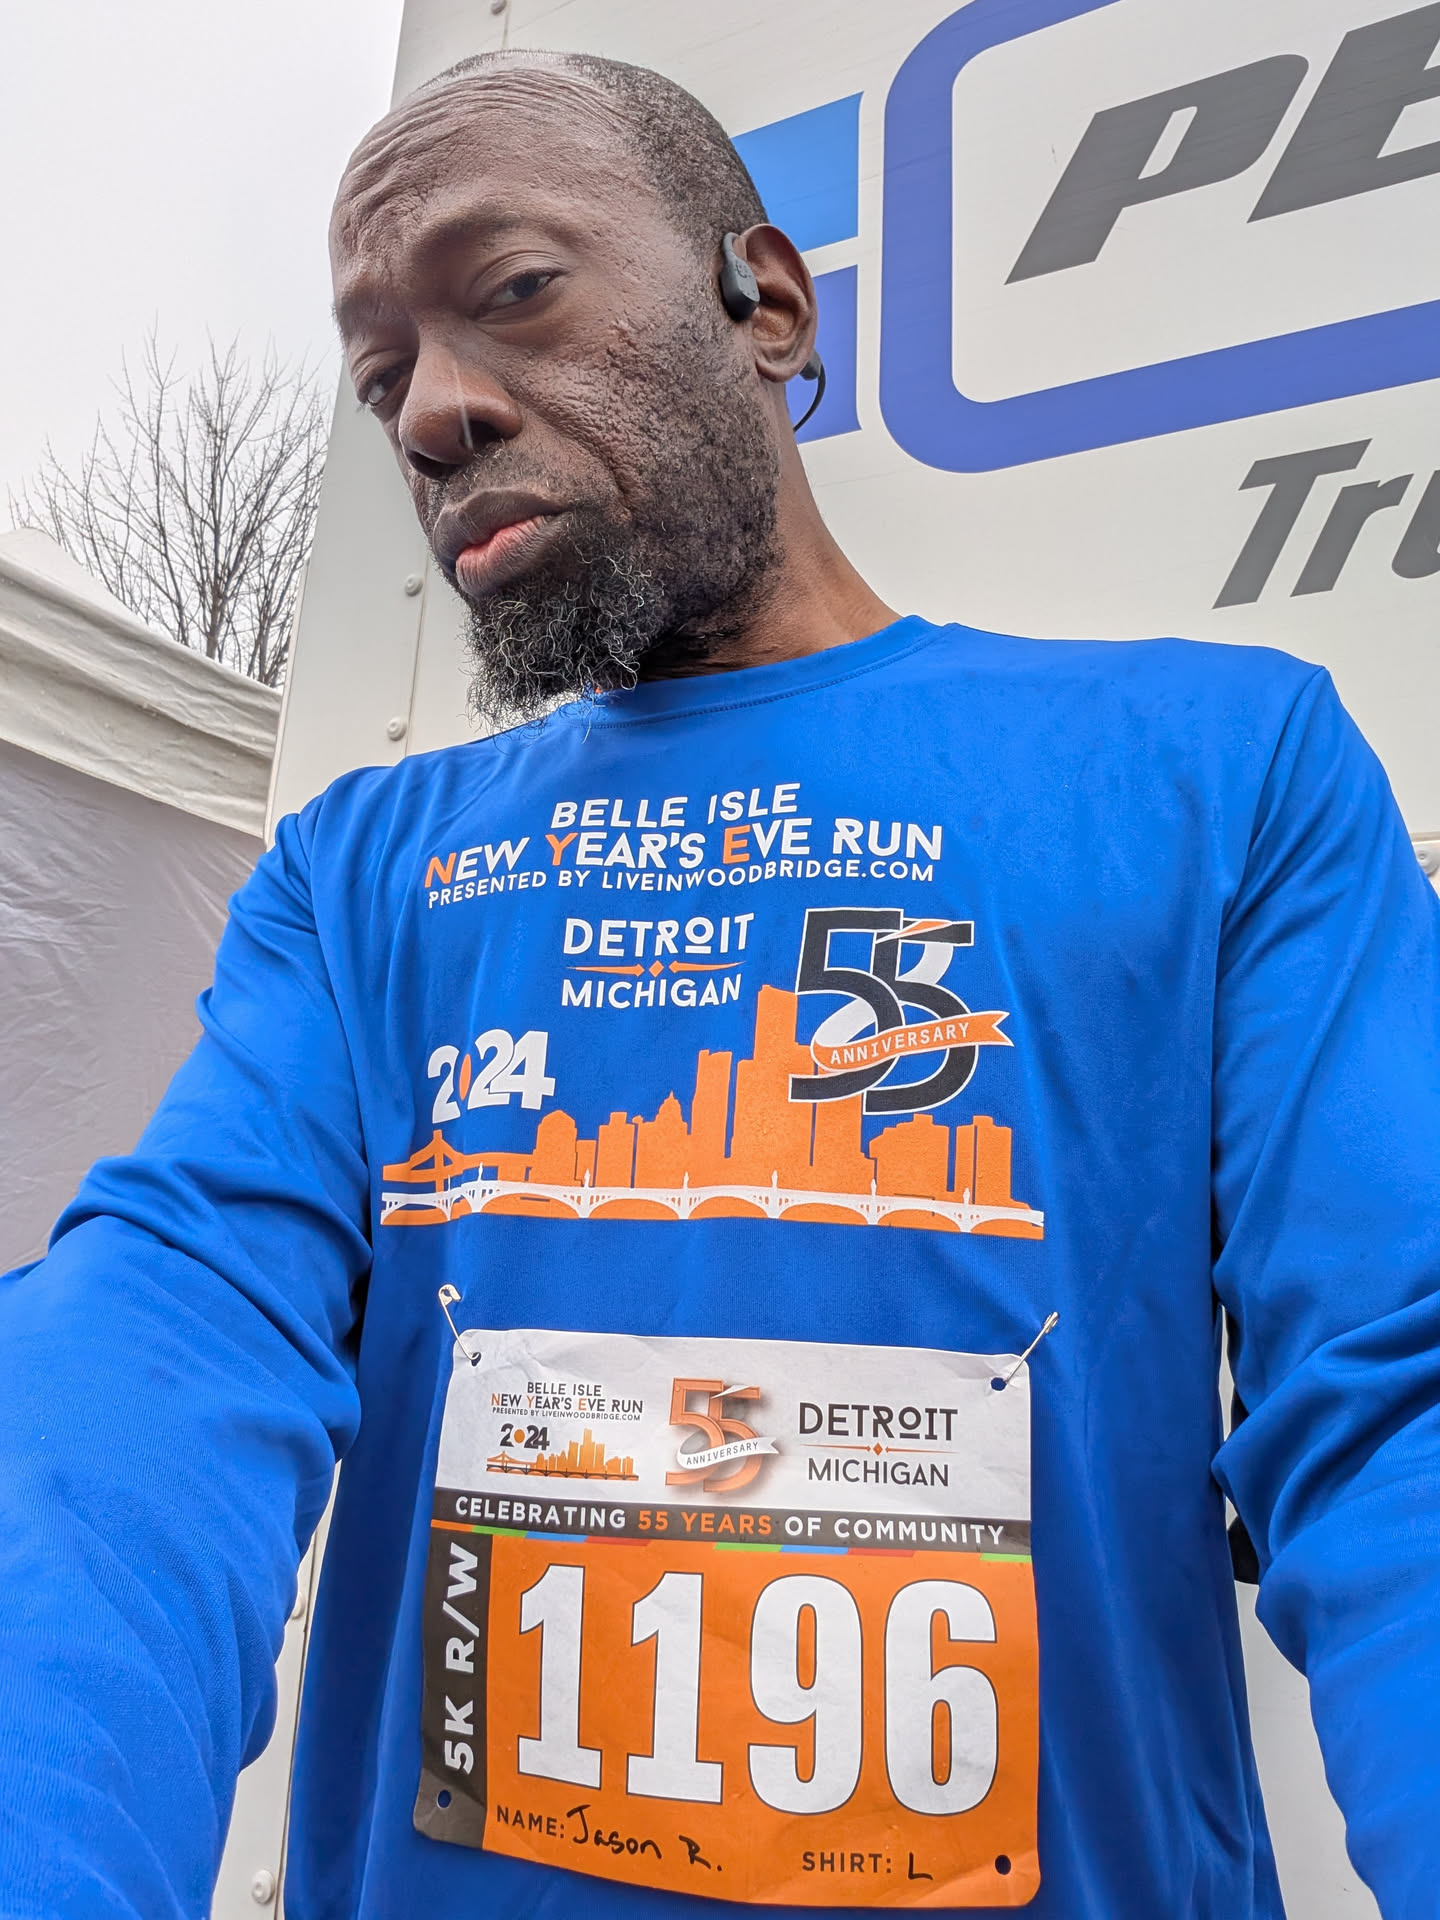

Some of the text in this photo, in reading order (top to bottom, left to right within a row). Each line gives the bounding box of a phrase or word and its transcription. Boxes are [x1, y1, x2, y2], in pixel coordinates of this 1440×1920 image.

[551, 782, 800, 829] BELLE ISLE
[424, 817, 943, 887] NEW YEAR'S EVE RUN
[428, 859, 934, 909] PRESENTED BY LIVEINWOODBRIDGE.COM
[562, 913, 755, 957] DETROIT
[561, 973, 742, 1010] MICHIGAN
[829, 1022, 970, 1065] ANNIVERSARY
[491, 1393, 643, 1414] NEW YEAR'S EVE RUN
[527, 1382, 602, 1397] BELLE ISLE
[492, 1407, 528, 1416] PRESENTED
[542, 1411, 641, 1421] LIVEINWOODBRIDGE.COM
[799, 1402, 959, 1442] DETROIT
[665, 1378, 762, 1493] 55
[686, 1441, 758, 1466] ANNIVERSARY
[807, 1457, 950, 1488] MICHIGAN
[455, 1496, 1005, 1546] CELEBRATING 55 YEARS OF COMMUNITY
[444, 1543, 480, 1775] 5K R/W
[517, 1563, 1000, 1816] 1196
[496, 1805, 565, 1840] NAME:
[565, 1804, 723, 1873] Jason R.
[802, 1852, 892, 1874] SHIRT:
[907, 1853, 934, 1882] L
